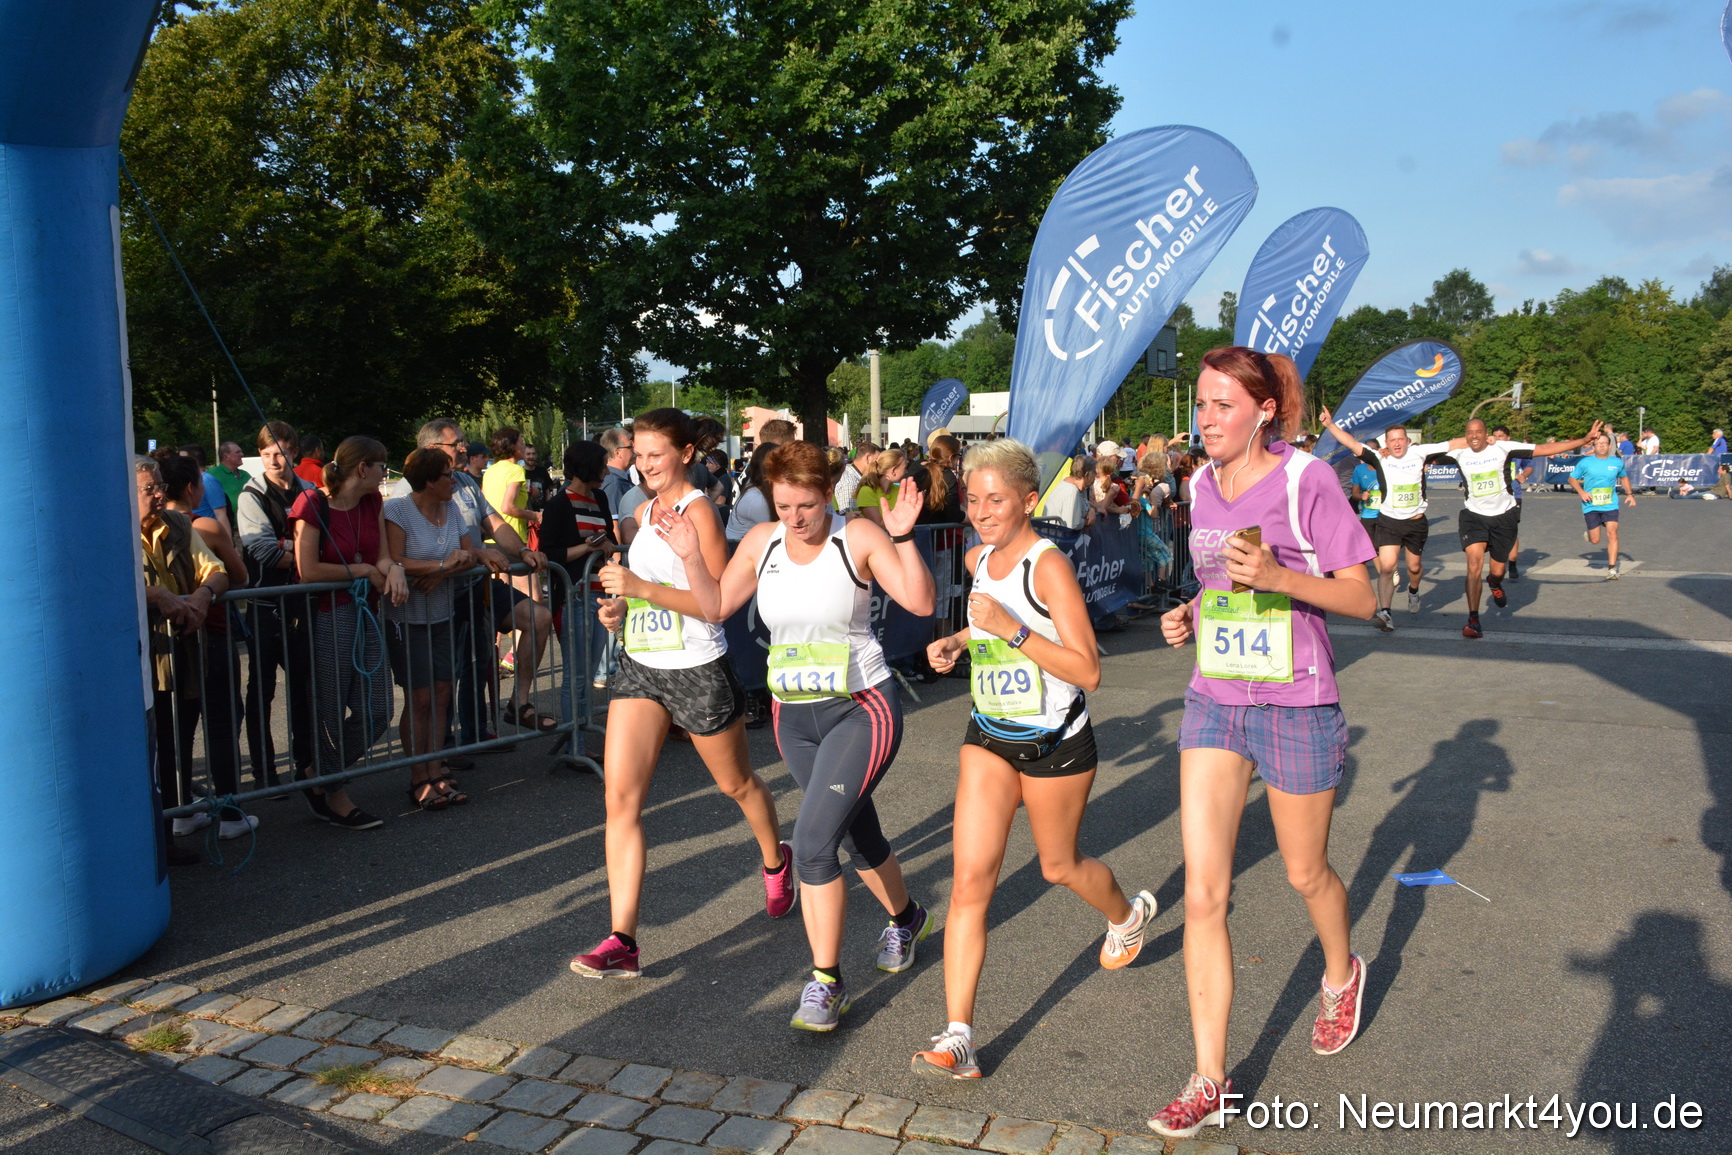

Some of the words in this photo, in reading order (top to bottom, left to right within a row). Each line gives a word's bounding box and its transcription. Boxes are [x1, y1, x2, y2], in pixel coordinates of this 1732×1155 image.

[1074, 165, 1204, 332] Fischer
[1118, 197, 1218, 331] AUTOMOBILE
[1264, 234, 1335, 354] Fischer
[1290, 257, 1346, 361] AUTOMOBILE
[930, 386, 957, 424] Fischer
[1334, 379, 1425, 430] Frischmann
[1393, 395, 1415, 411] Druck
[1416, 388, 1430, 399] und
[1429, 373, 1456, 392] Medien
[1477, 480, 1494, 490] 279
[1652, 467, 1703, 477] Fischer
[1398, 493, 1415, 501] 283
[631, 609, 672, 633] 1130
[1214, 627, 1271, 656] 514
[776, 671, 836, 692] 1131
[977, 668, 1031, 695] 1129
